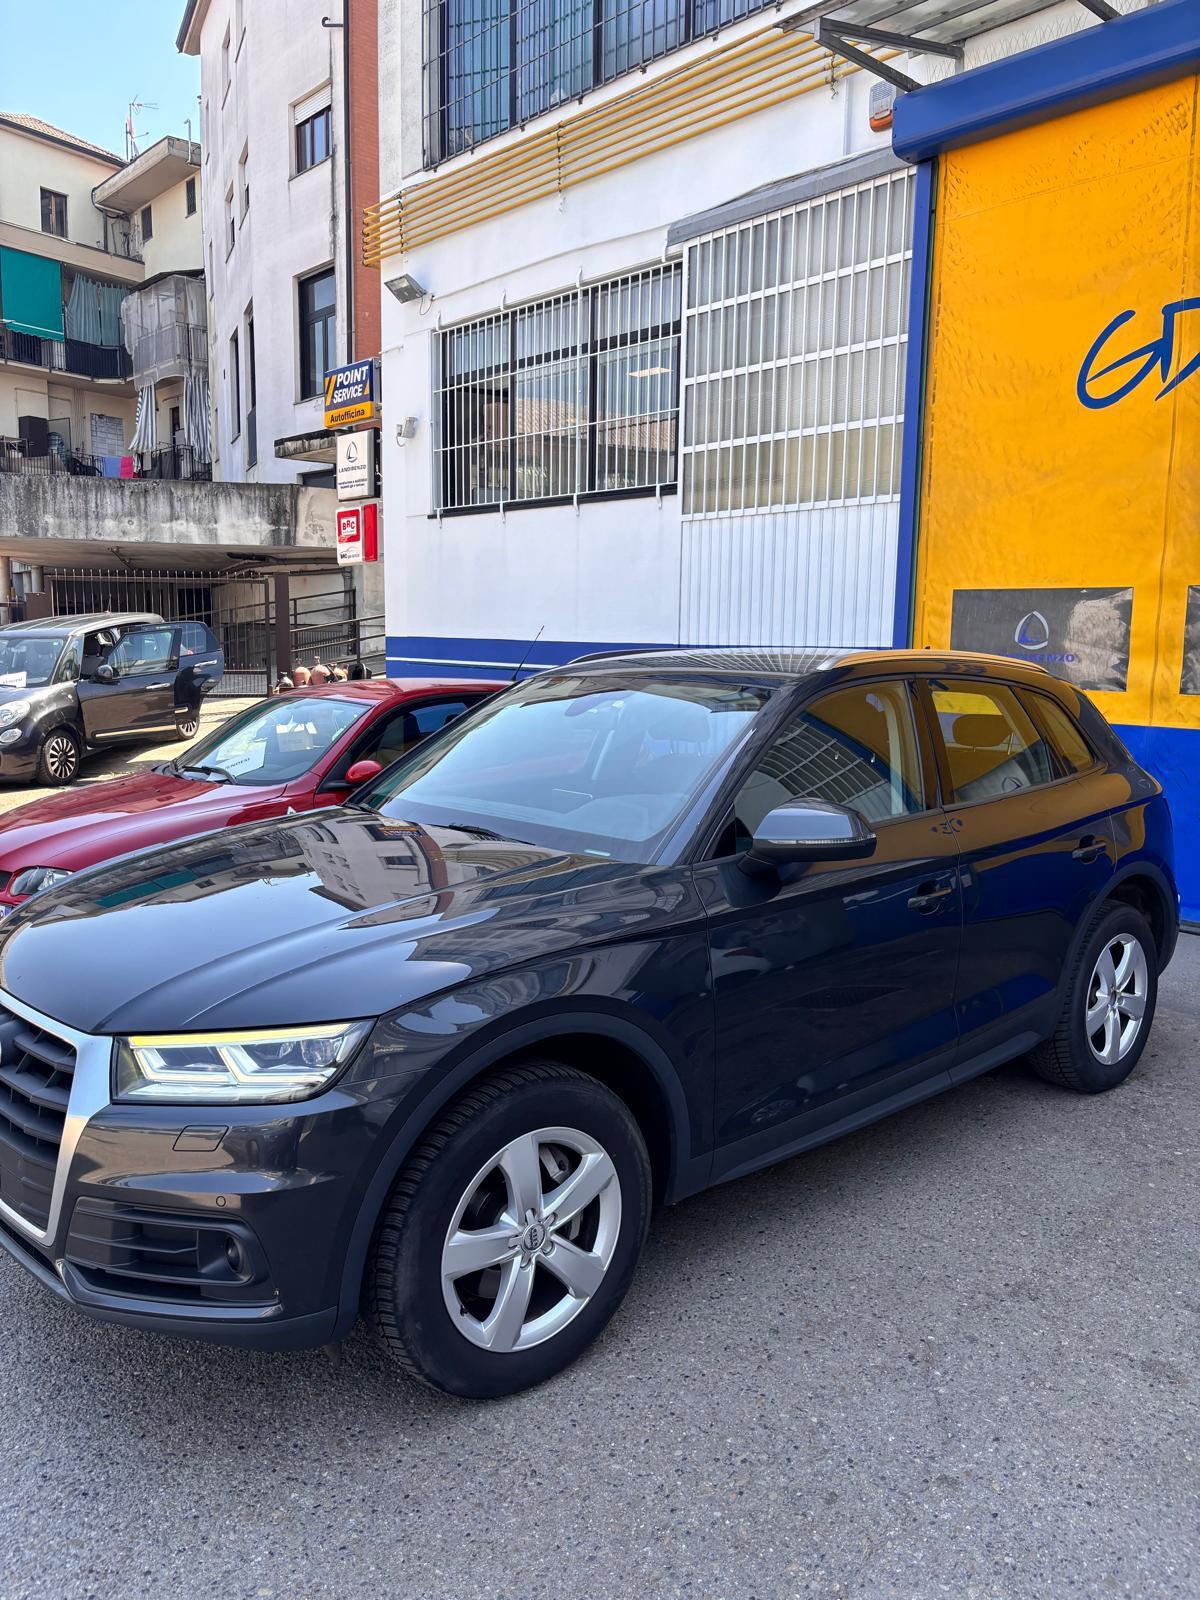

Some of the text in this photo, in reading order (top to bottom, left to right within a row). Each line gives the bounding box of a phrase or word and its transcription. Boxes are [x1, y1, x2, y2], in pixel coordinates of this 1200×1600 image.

[336, 365, 369, 387] POINT
[333, 384, 363, 404] SERVICE
[330, 408, 365, 423] Autofficina
[342, 520, 356, 530] BRC
